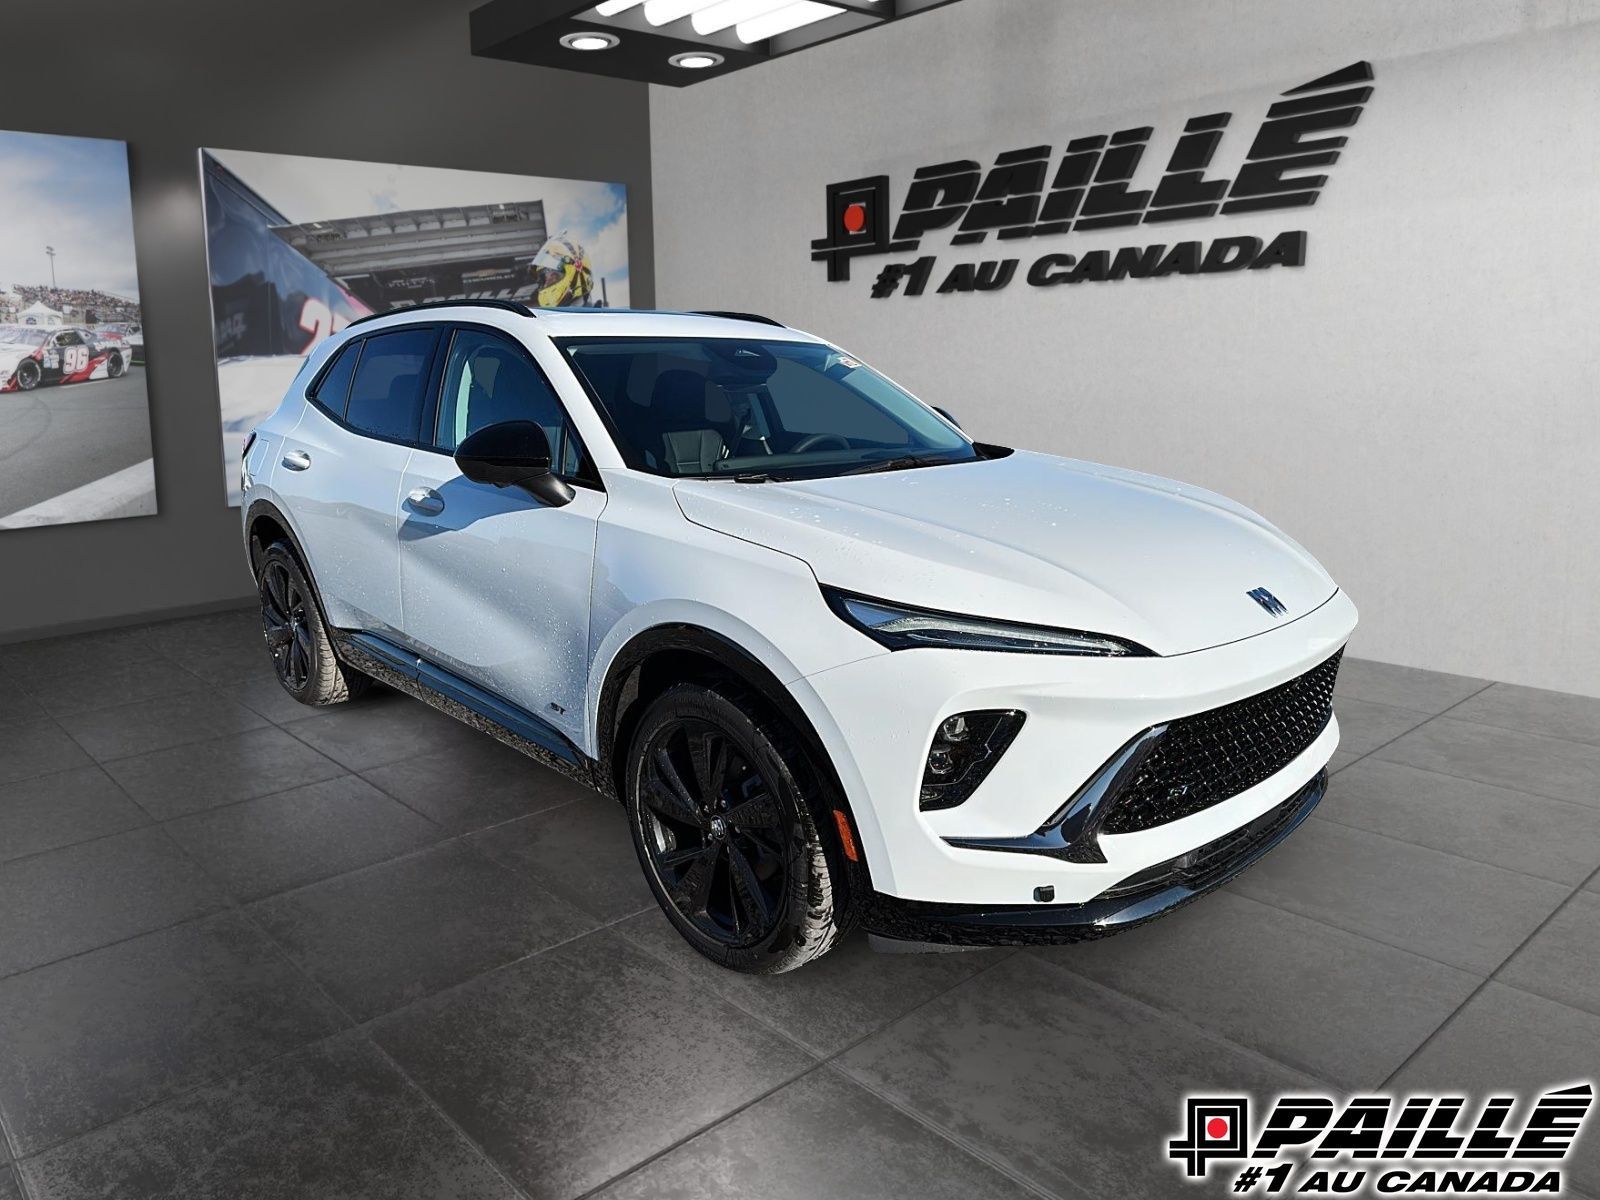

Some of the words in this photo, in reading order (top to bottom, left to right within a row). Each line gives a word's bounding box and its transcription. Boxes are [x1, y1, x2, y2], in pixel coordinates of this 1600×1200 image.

[889, 61, 1374, 252] PAILLÉ
[871, 255, 936, 298] #1
[936, 259, 1019, 293] AU
[1026, 230, 1307, 287] CANADA
[63, 345, 89, 374] 96
